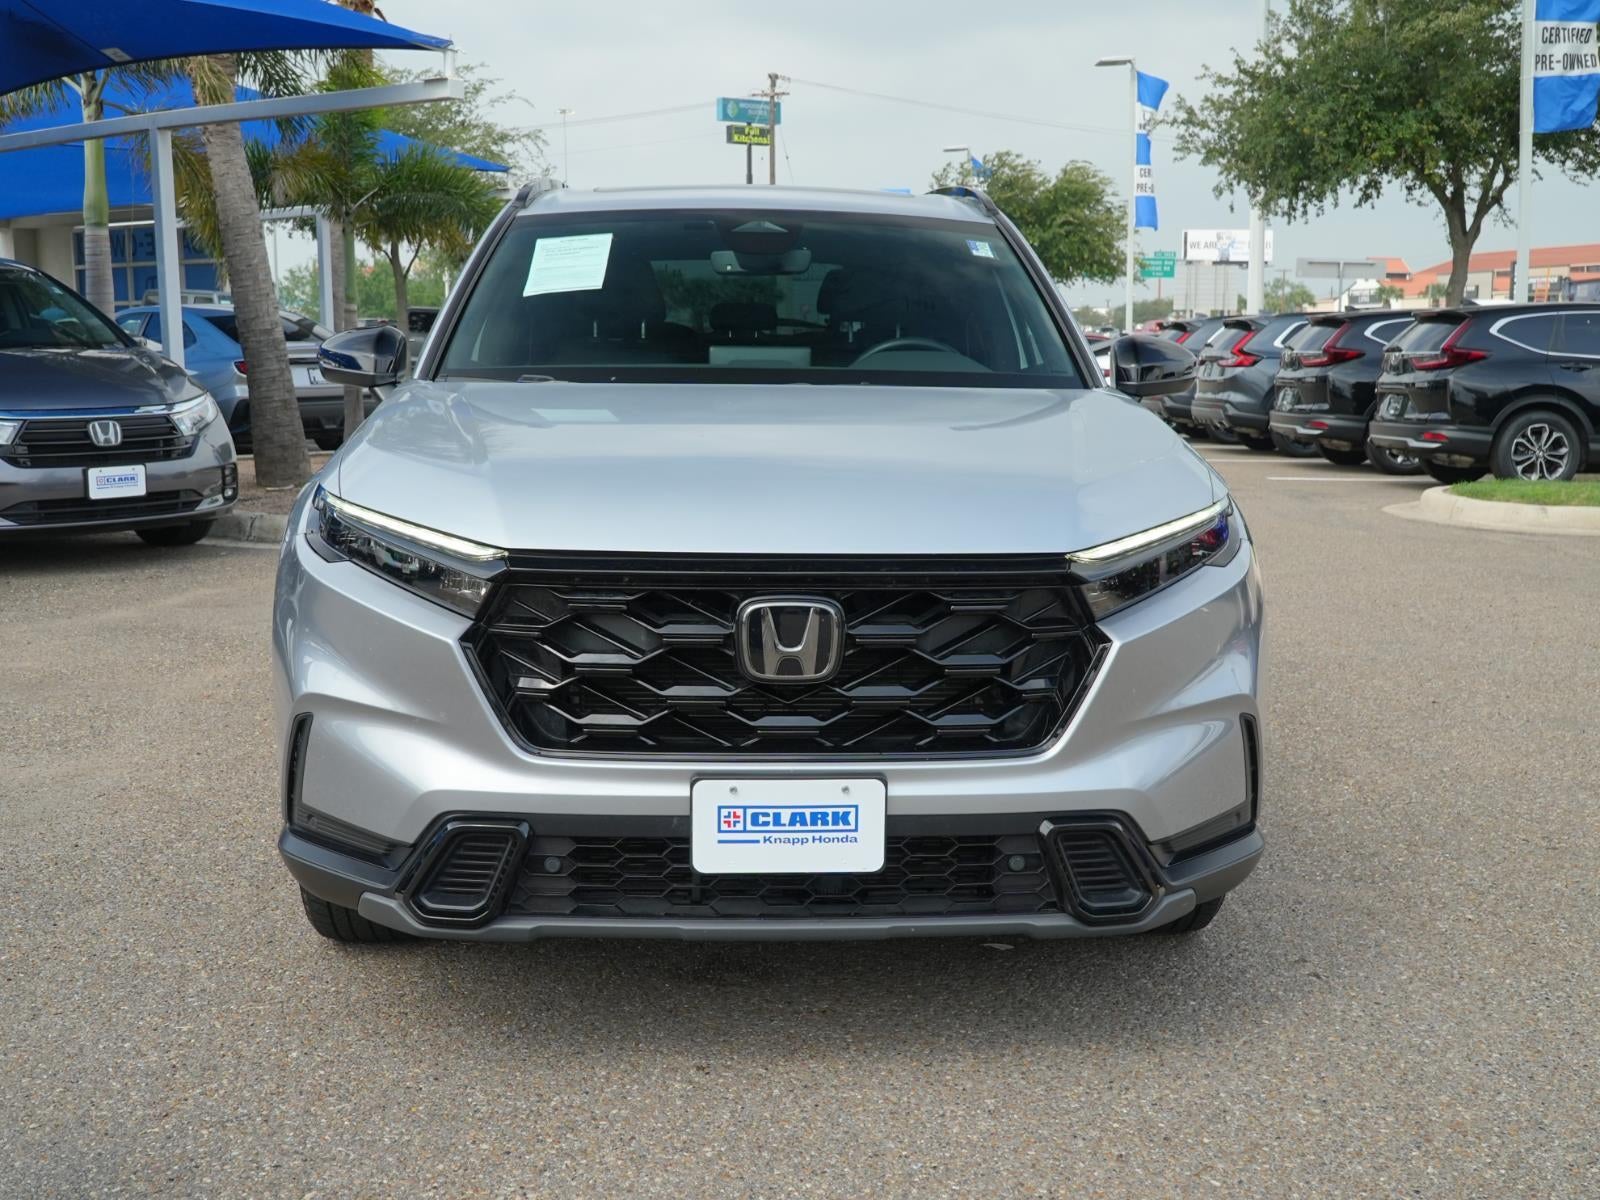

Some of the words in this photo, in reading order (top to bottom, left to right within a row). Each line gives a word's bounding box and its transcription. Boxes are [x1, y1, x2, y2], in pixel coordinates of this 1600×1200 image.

[1541, 26, 1592, 44] CERTIFIED
[1535, 53, 1597, 71] PRE-OWNED
[1189, 240, 1201, 249] WE
[106, 475, 136, 484] CLARK
[750, 811, 852, 827] CLARK
[763, 835, 809, 845] Knapp
[812, 834, 858, 844] Honda
